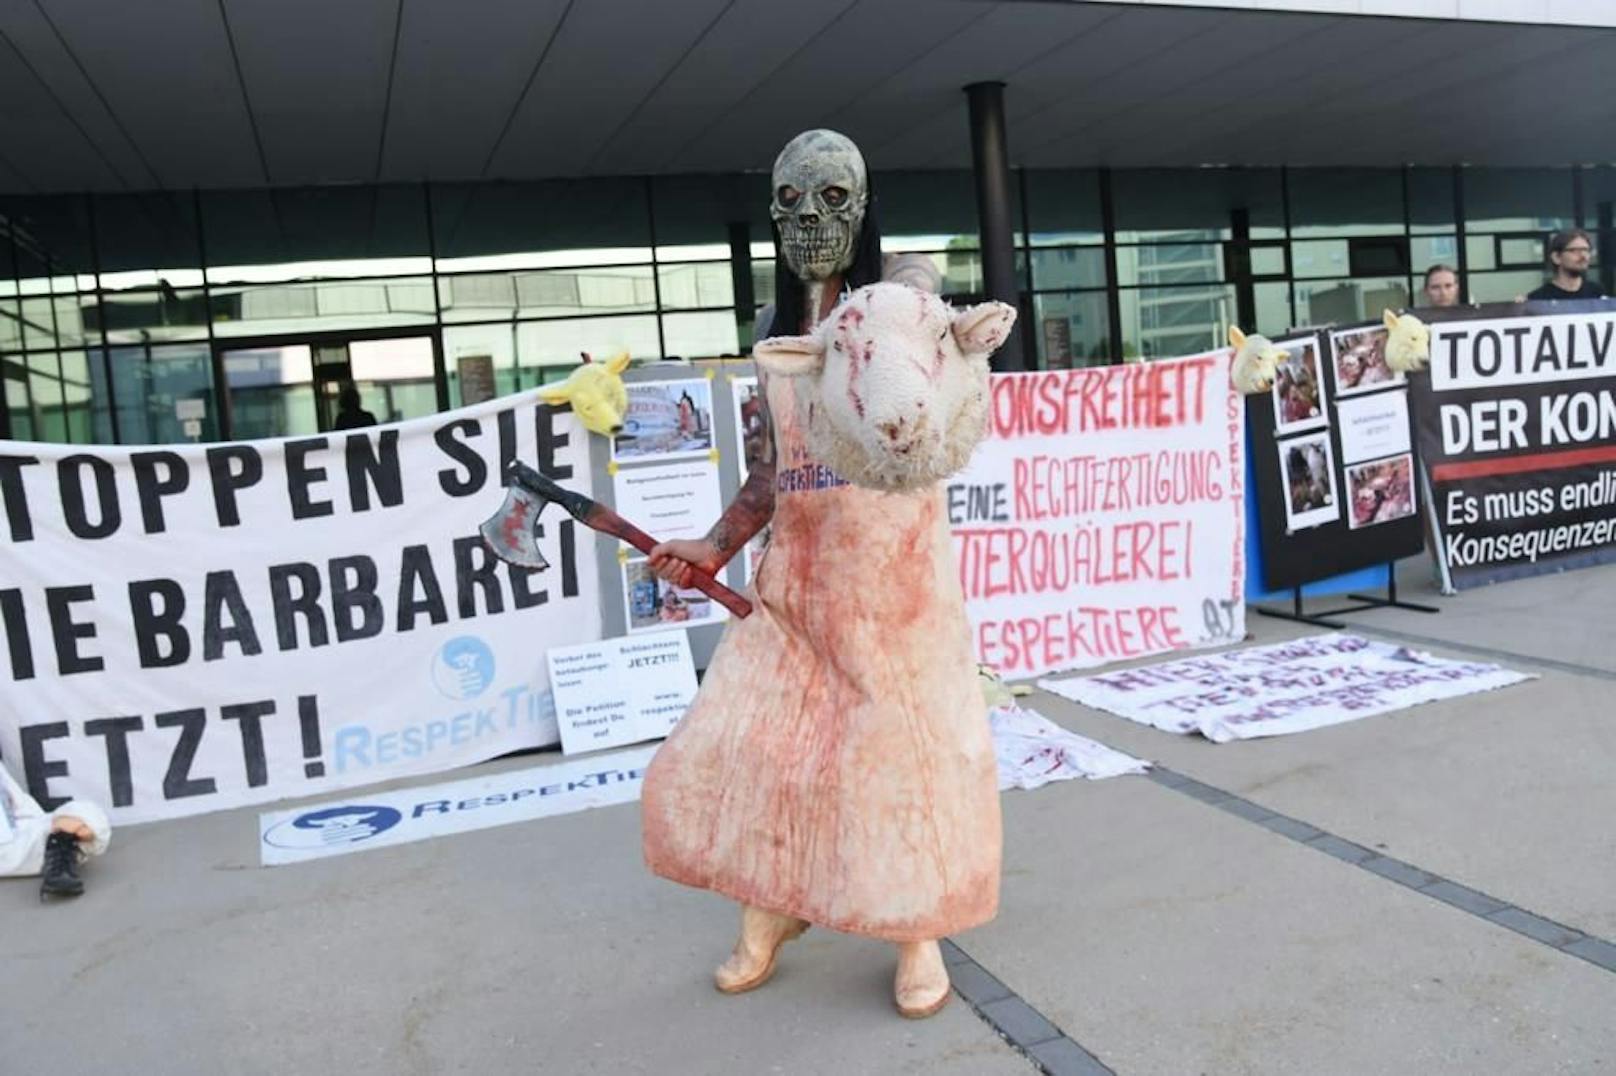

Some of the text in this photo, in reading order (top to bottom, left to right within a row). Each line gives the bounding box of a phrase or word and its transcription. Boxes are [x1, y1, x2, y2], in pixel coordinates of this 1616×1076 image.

[1439, 321, 1614, 379] TOTALV
[1440, 390, 1616, 456] DER KON
[0, 403, 575, 542] TOPPEN SIE
[947, 450, 1223, 525] EINE RECHTFERTIGUNG
[1446, 470, 1616, 525] Es muss endli
[951, 519, 1193, 602] TIERQUÄLEREI
[0, 519, 580, 681] IE BARBAREI
[627, 653, 679, 669] JETZT!!!
[0, 695, 325, 812] ETZT!
